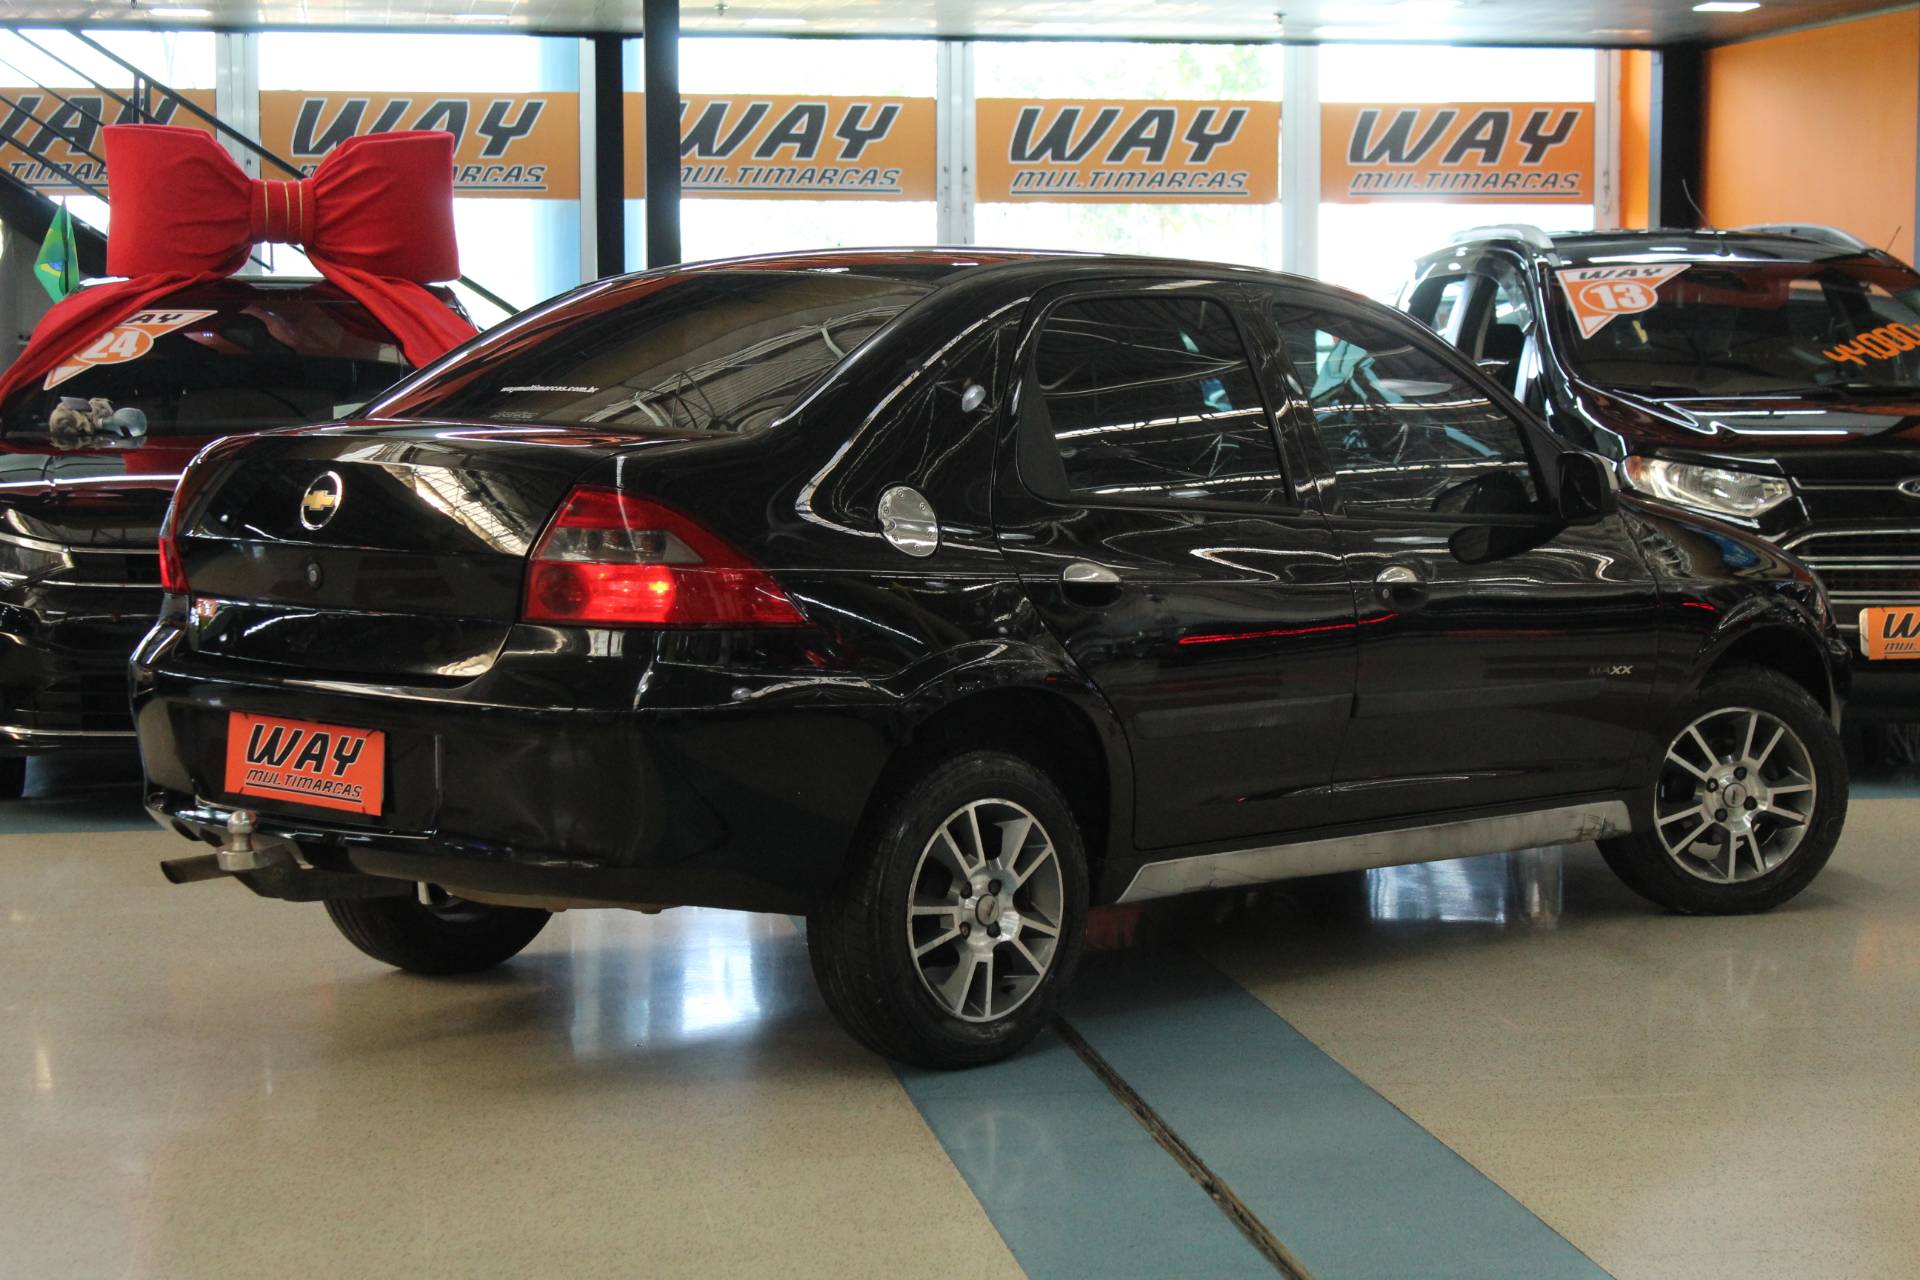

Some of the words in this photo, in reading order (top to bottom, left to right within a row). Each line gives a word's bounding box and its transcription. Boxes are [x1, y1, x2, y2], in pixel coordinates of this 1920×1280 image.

[680, 102, 900, 160] WAY
[1010, 107, 1248, 163] WAY
[1349, 110, 1580, 164] WAY
[1012, 170, 1248, 188] MULTIMARCAS
[1351, 172, 1580, 189] MULTIMARCAS
[1578, 267, 1662, 280] WAY
[1590, 283, 1649, 309] 13
[126, 313, 184, 323] AY
[80, 330, 142, 360] 24
[246, 724, 365, 777] WAY
[246, 769, 363, 798] MULTIMARCAS
